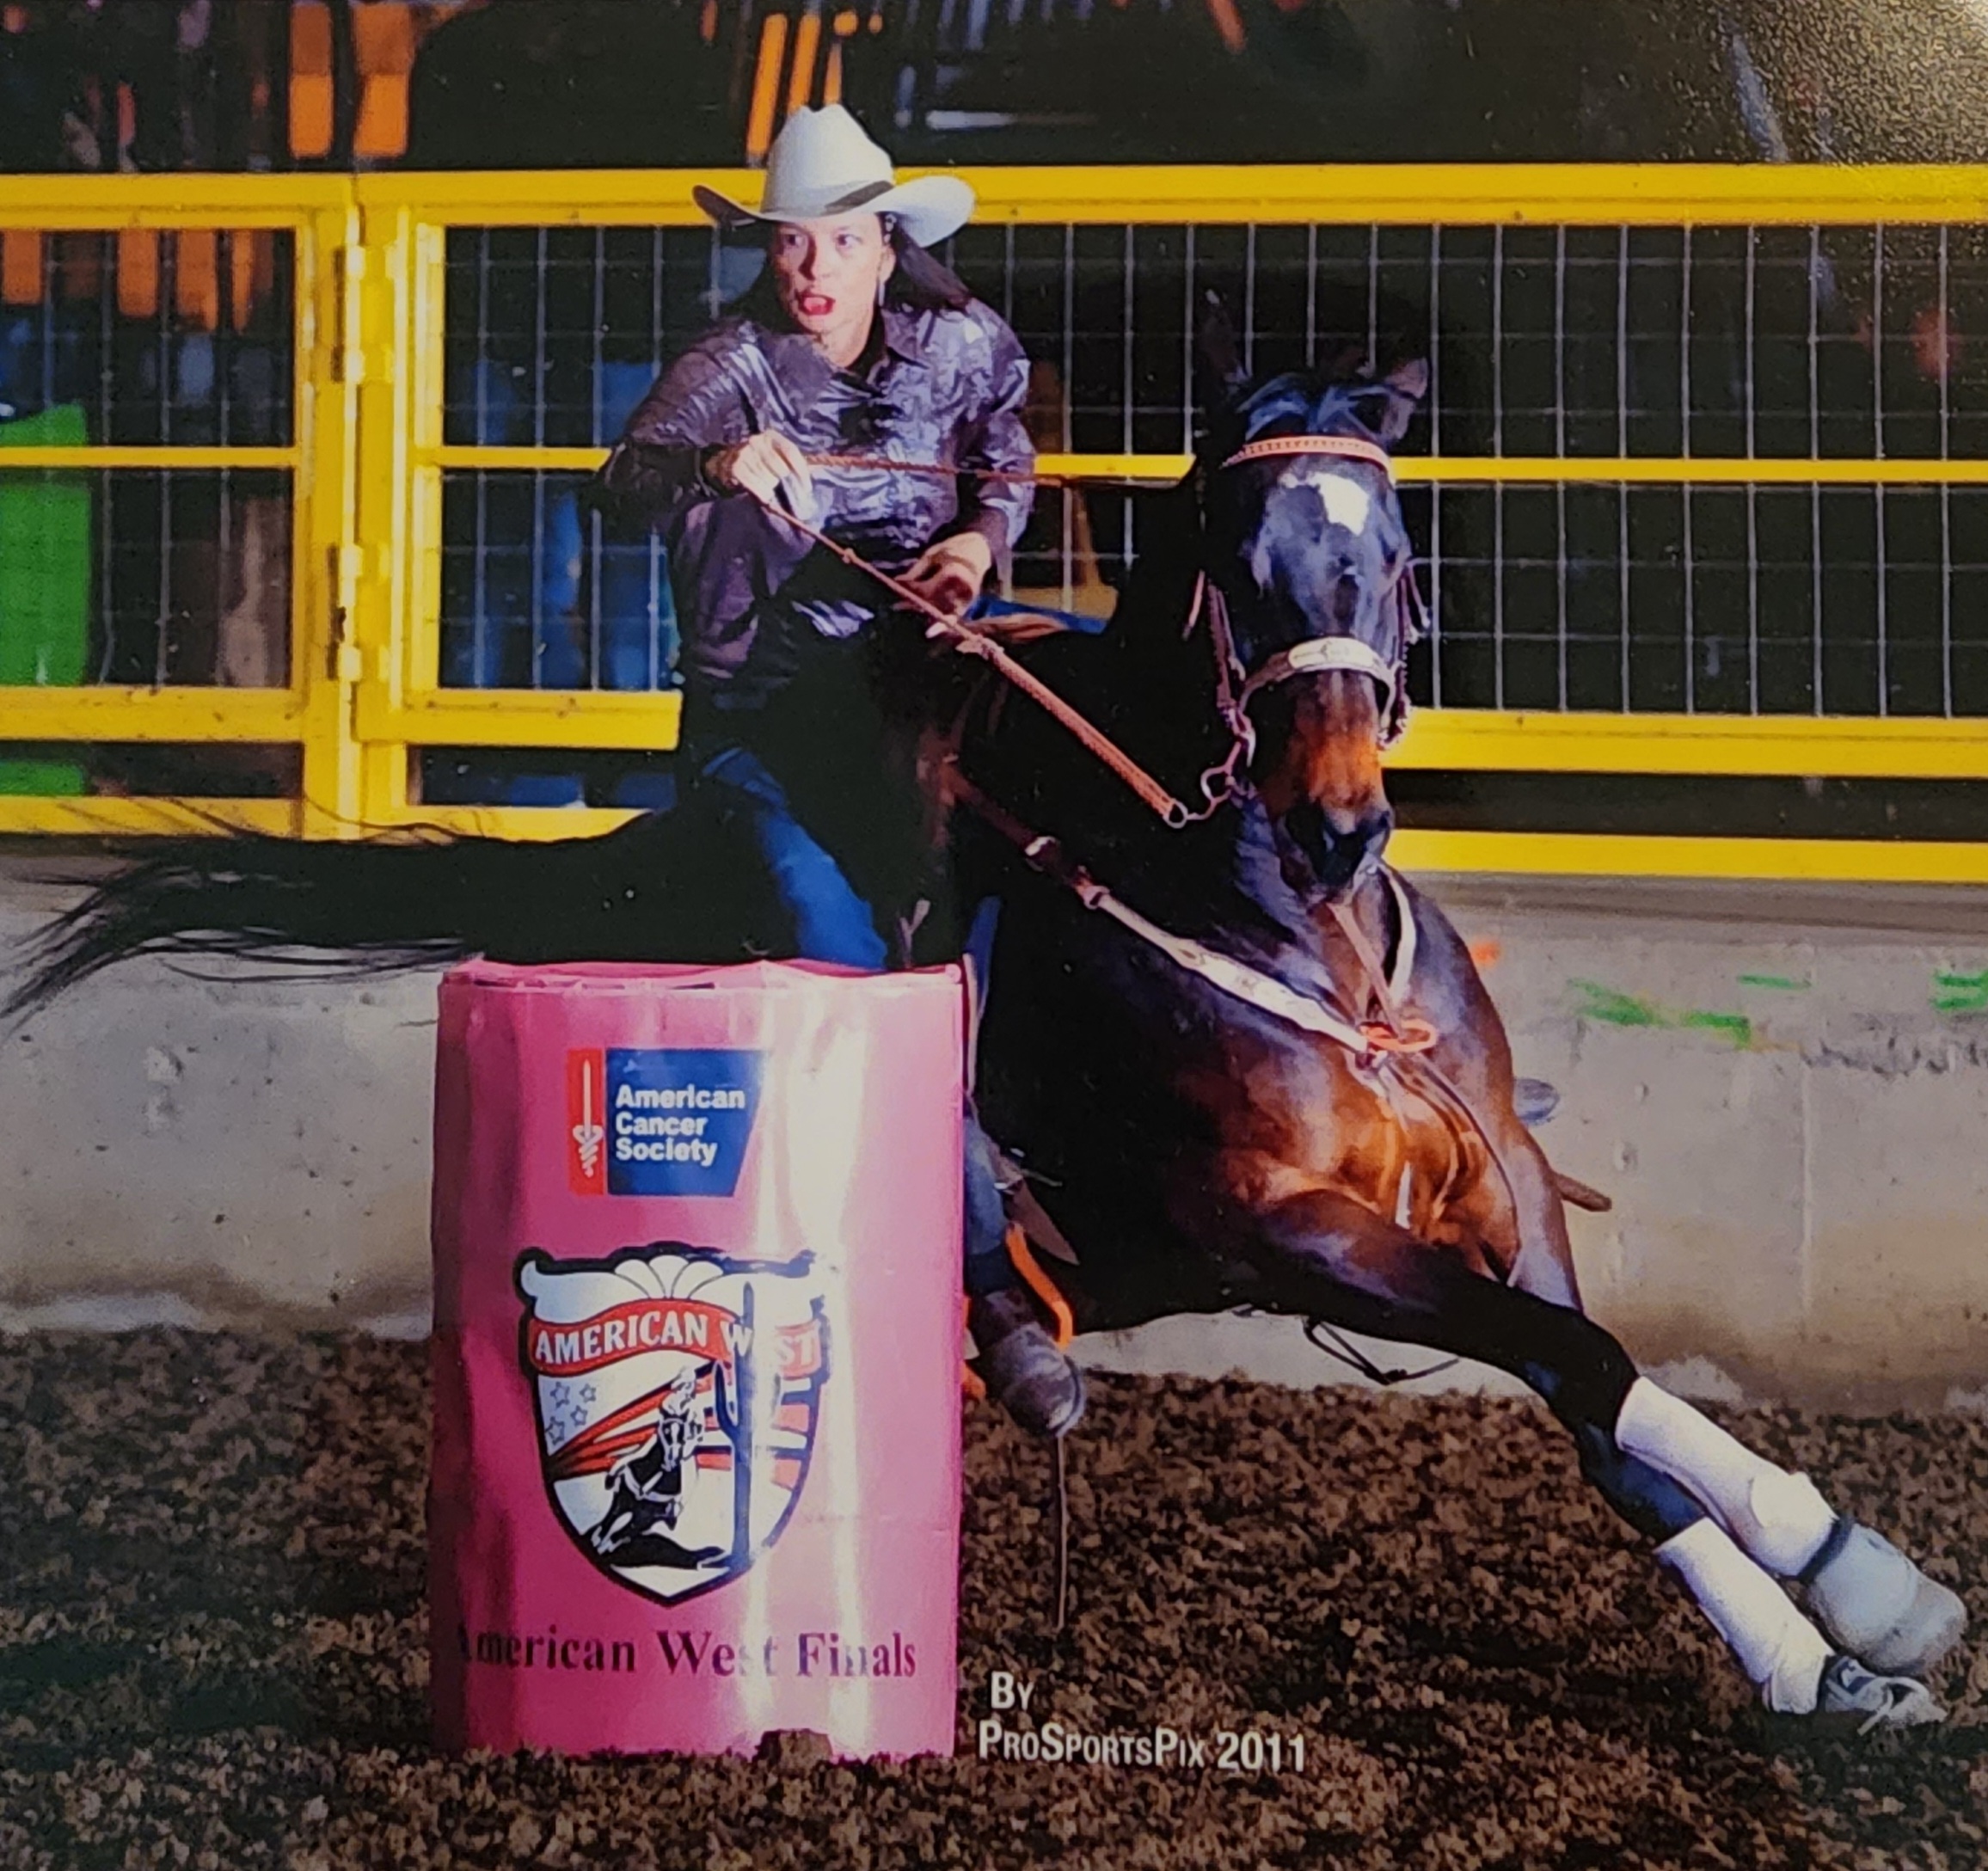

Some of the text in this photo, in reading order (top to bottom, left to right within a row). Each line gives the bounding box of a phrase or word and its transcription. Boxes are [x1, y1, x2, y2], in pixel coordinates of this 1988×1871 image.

[615, 1084, 746, 1109] American
[616, 1113, 709, 1137] Cancer
[615, 1138, 718, 1166] Society
[535, 1311, 815, 1366] AMERICAN WST
[796, 1631, 917, 1678] Finals
